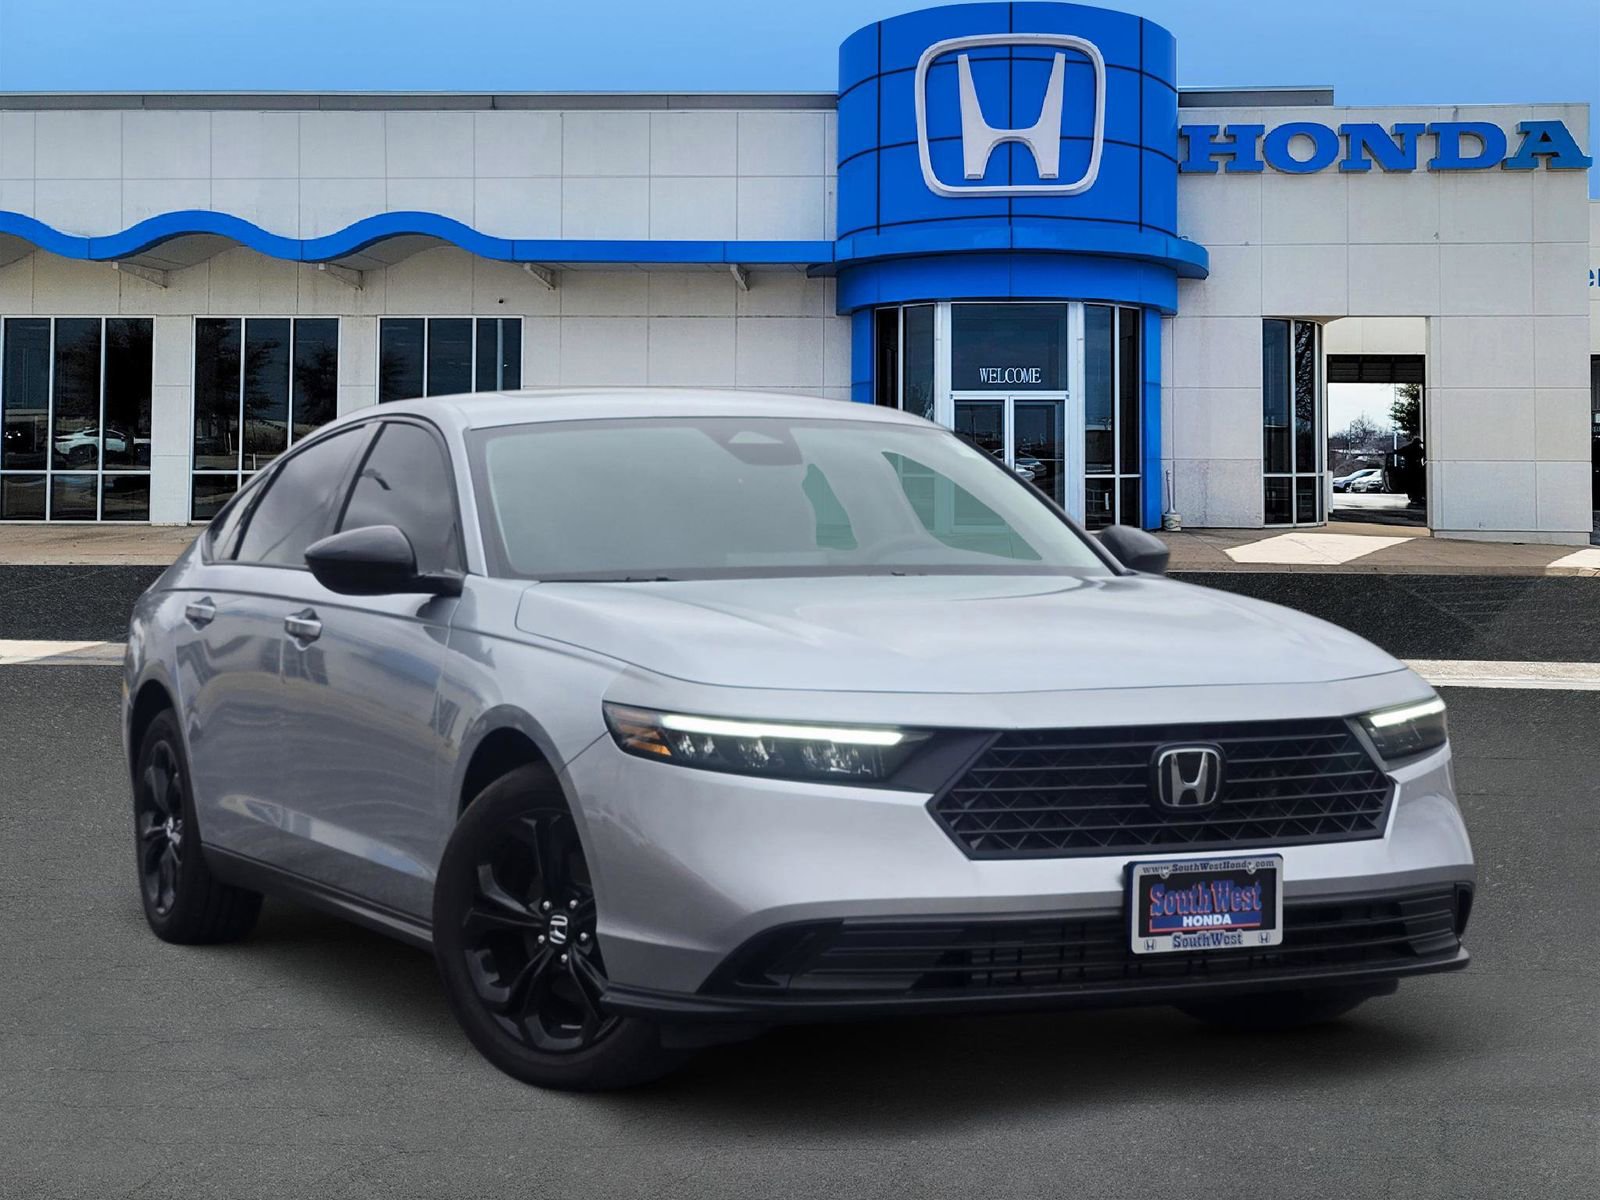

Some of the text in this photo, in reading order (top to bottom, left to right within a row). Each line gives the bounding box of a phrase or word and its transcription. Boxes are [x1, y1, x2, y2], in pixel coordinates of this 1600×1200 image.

[1179, 120, 1593, 174] HONDA
[979, 367, 1042, 384] WELCOME
[1142, 860, 1275, 874] www.SouthWestHond.com
[1149, 879, 1262, 916] SouthWest
[1182, 914, 1233, 927] HONDA
[1172, 931, 1244, 949] SouthWest
